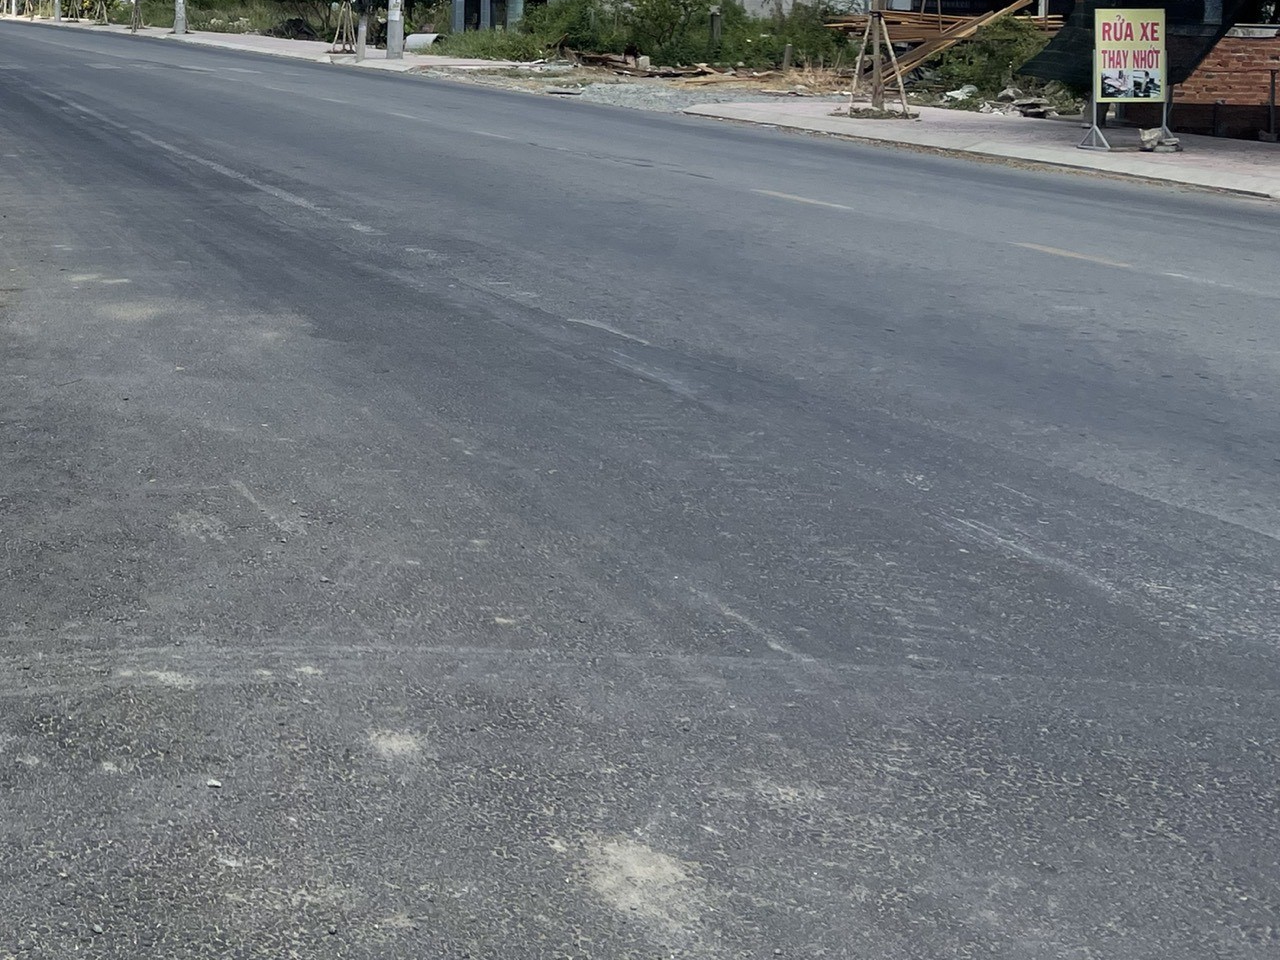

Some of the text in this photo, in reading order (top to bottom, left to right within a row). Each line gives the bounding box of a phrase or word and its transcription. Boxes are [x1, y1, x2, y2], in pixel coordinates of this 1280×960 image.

[1102, 14, 1160, 41] RỬA XE
[1101, 44, 1161, 69] THAY NHỚT
